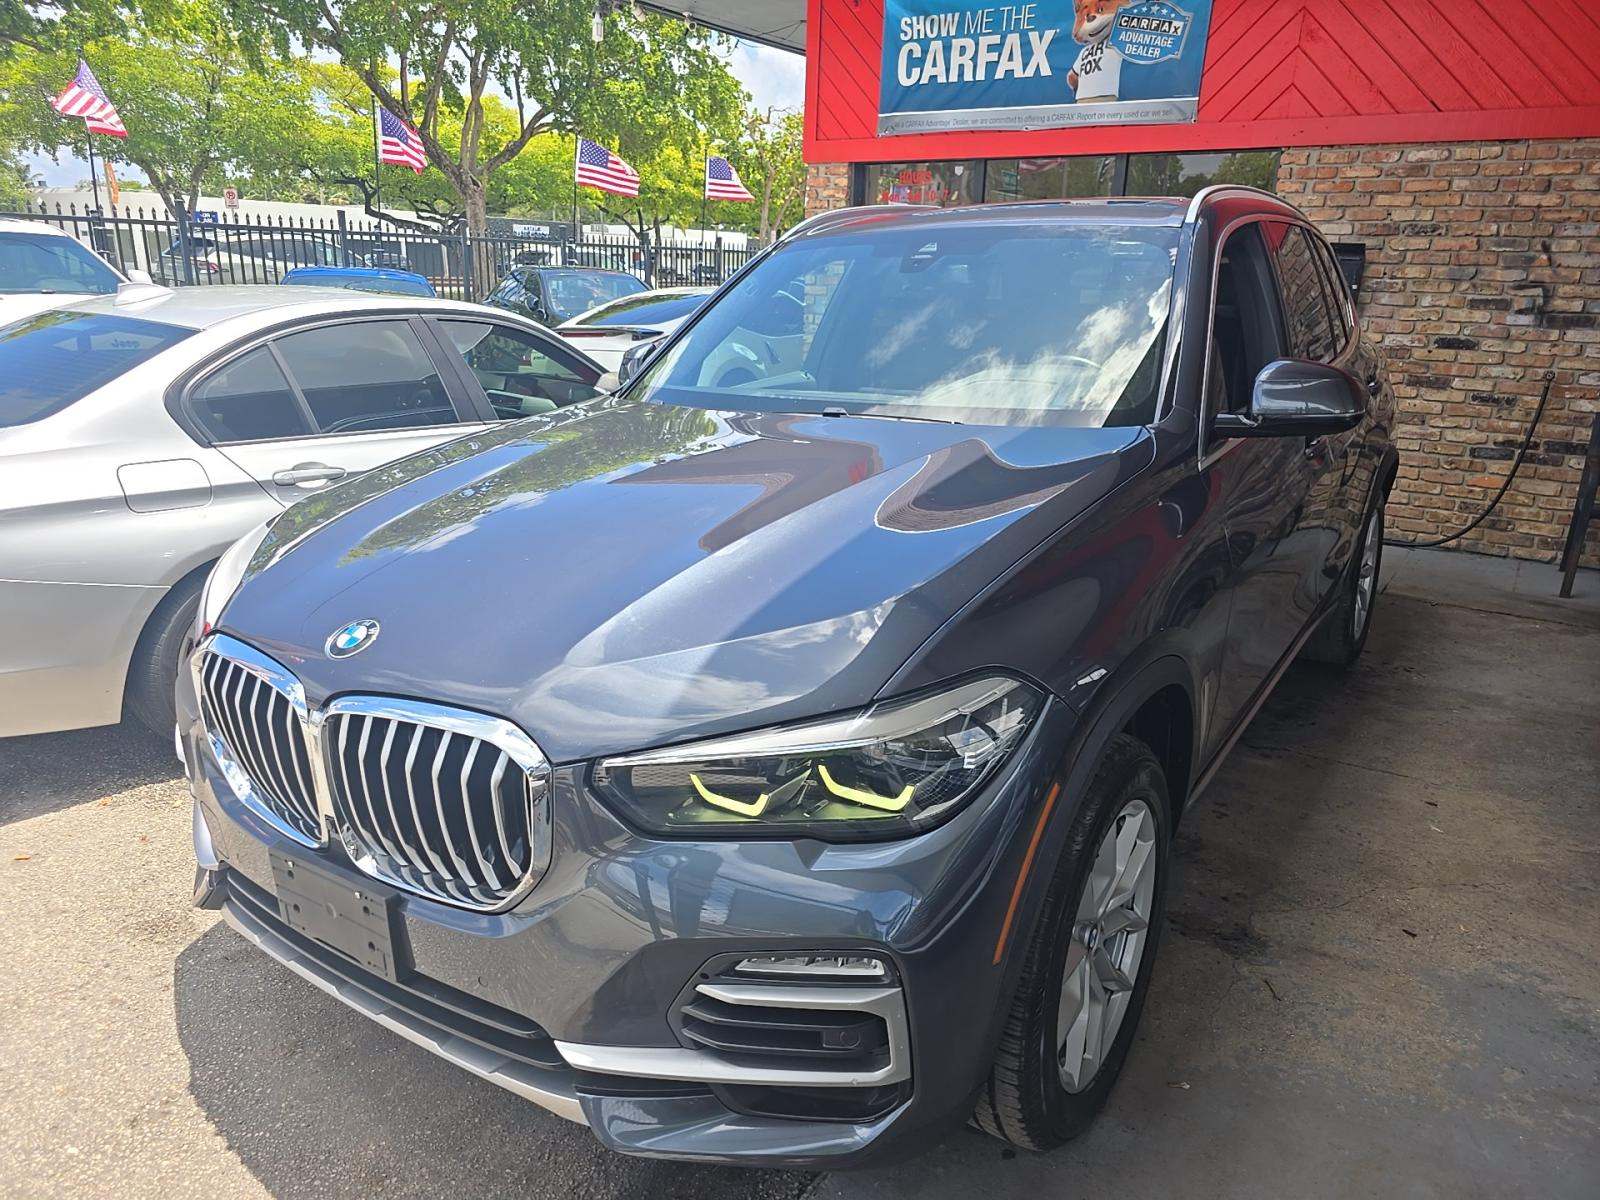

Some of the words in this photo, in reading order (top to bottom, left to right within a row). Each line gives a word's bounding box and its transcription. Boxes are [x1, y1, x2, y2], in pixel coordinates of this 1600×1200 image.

[900, 12, 960, 41] SHOW
[964, 9, 994, 35] ME
[1000, 4, 1037, 31] THE
[1119, 15, 1183, 35] CARFAX
[1119, 31, 1175, 48] ADVANTAGE
[897, 29, 1057, 87] CARFAX
[1082, 41, 1104, 60] CAR
[1125, 43, 1161, 58] DEALER
[1080, 57, 1102, 76] FOX
[1077, 111, 1097, 121] Report
[1106, 112, 1123, 120] every
[1124, 110, 1140, 119] used
[899, 171, 932, 184] HOURS
